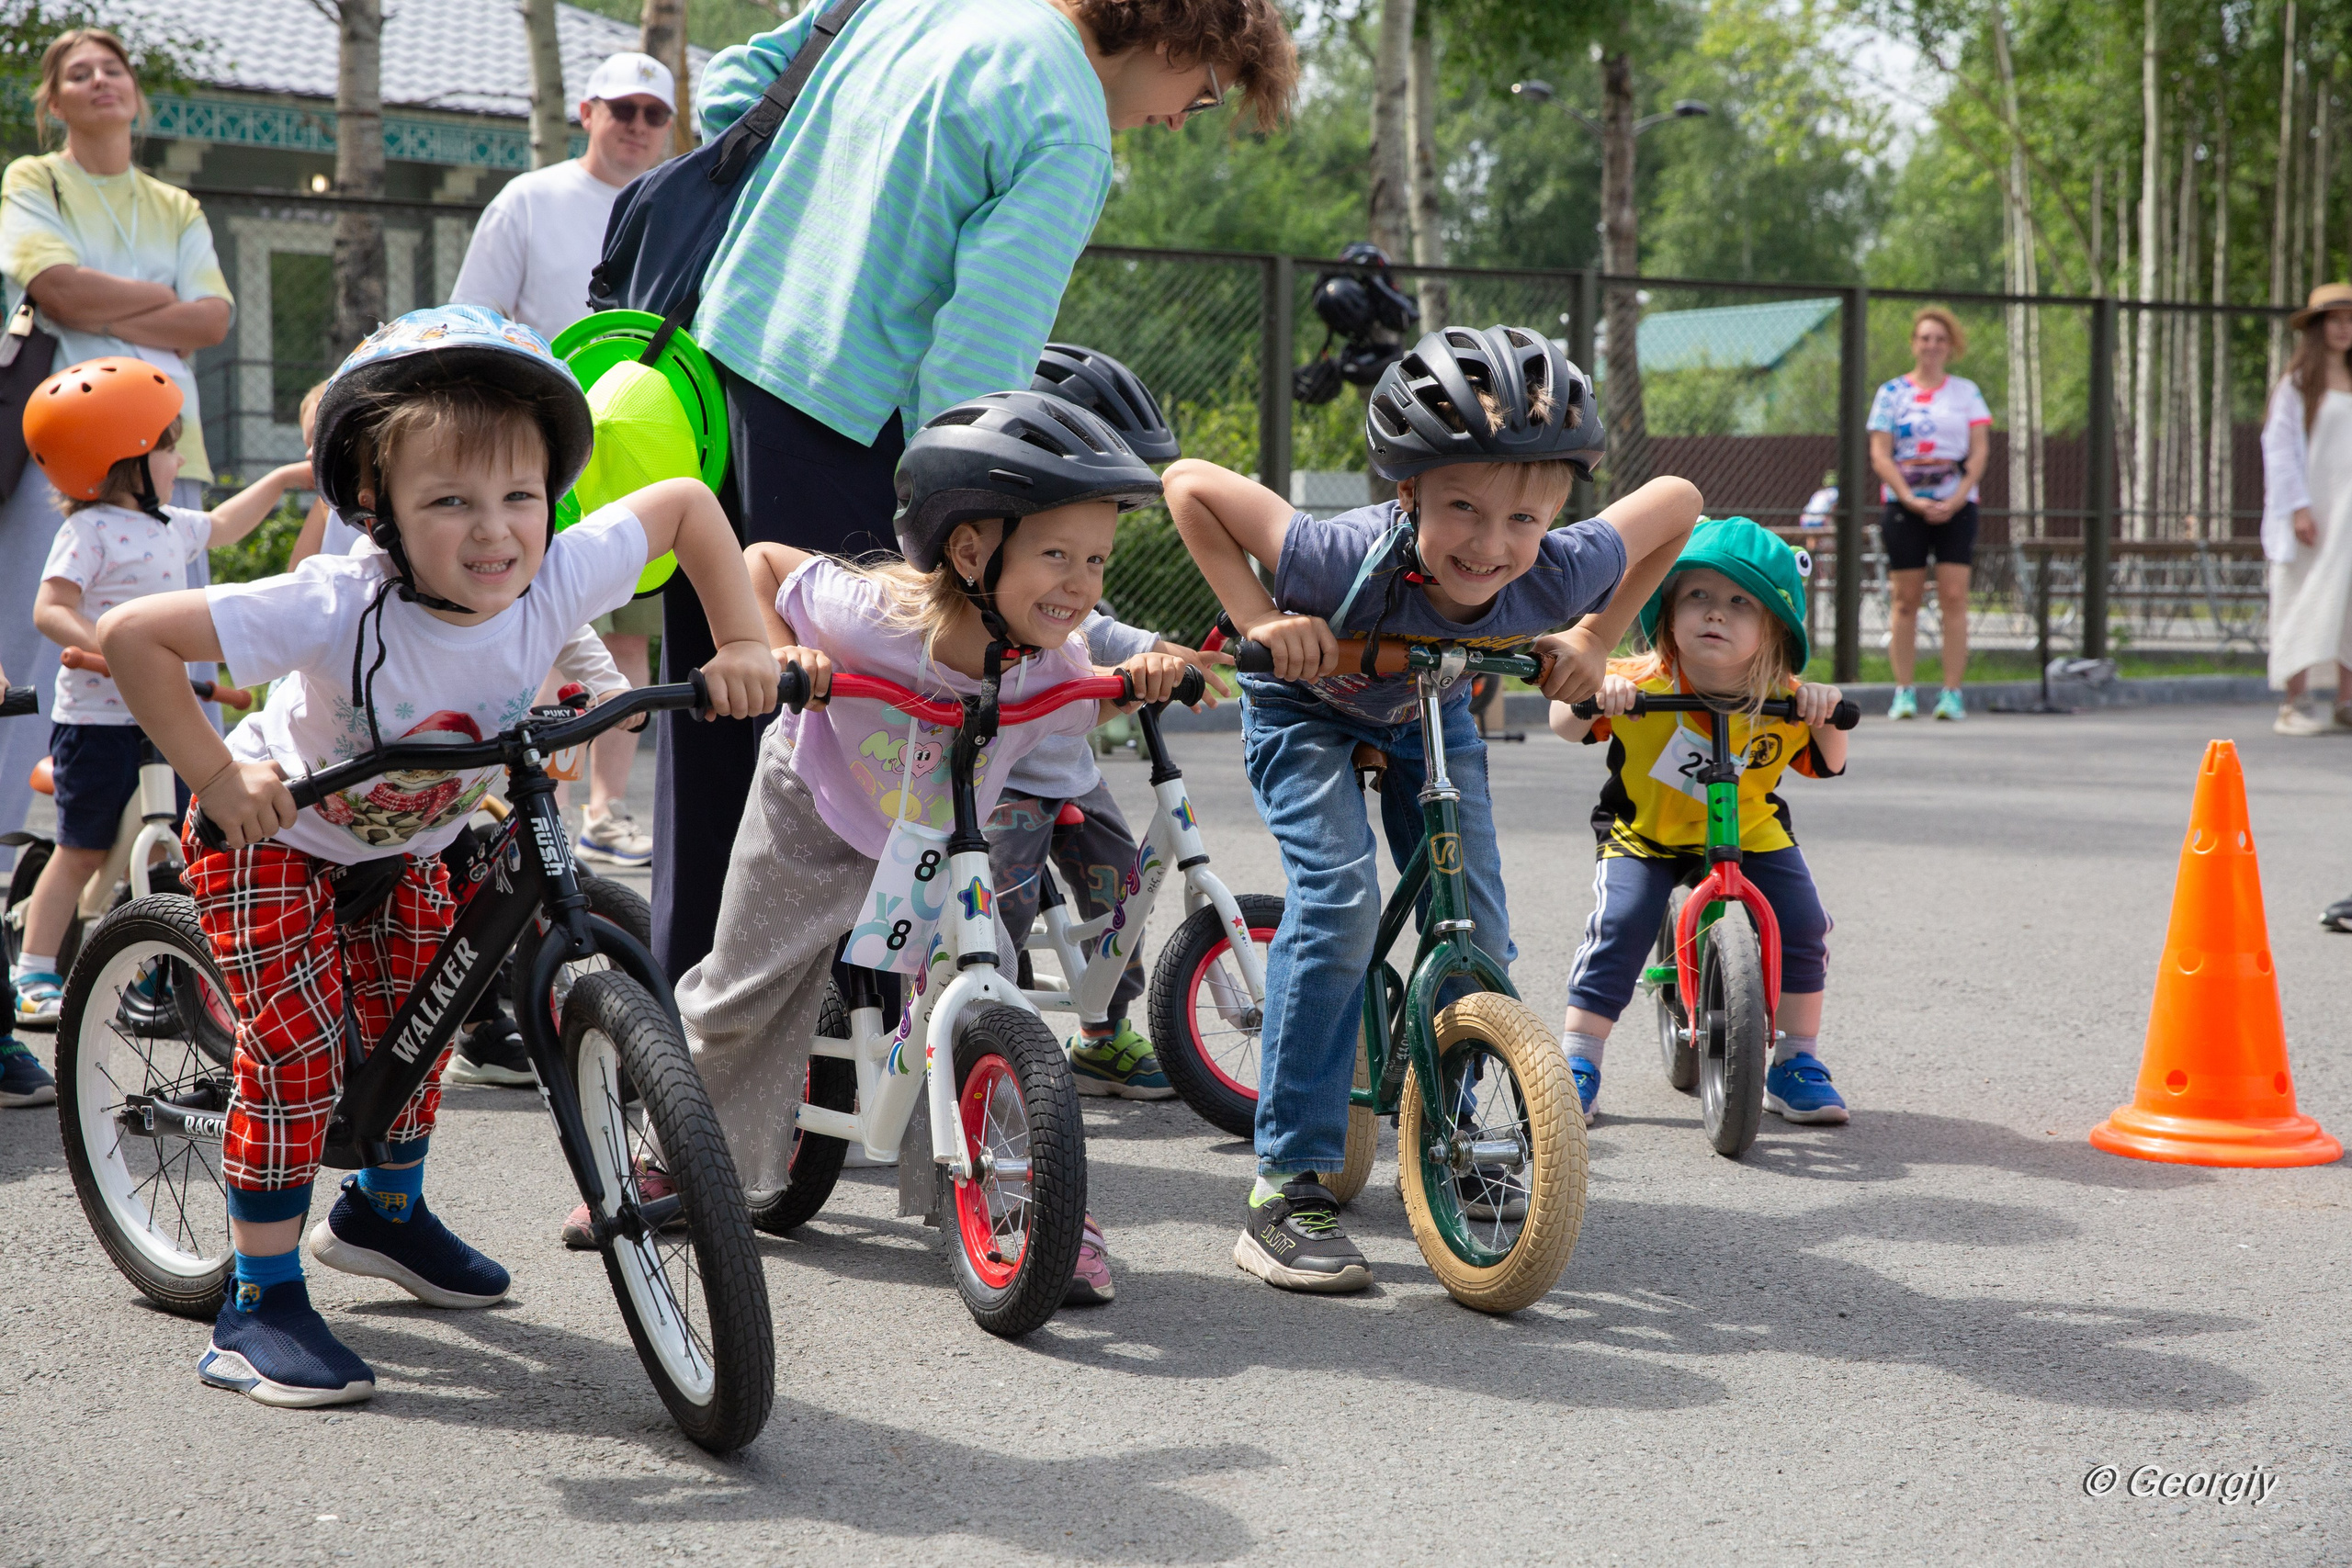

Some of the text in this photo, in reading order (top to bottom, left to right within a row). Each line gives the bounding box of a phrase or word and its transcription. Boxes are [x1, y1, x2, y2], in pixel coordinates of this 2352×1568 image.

[542, 709, 571, 717] PUKY
[914, 849, 942, 882] 8
[887, 919, 912, 951] 8
[391, 936, 480, 1065] WALKER
